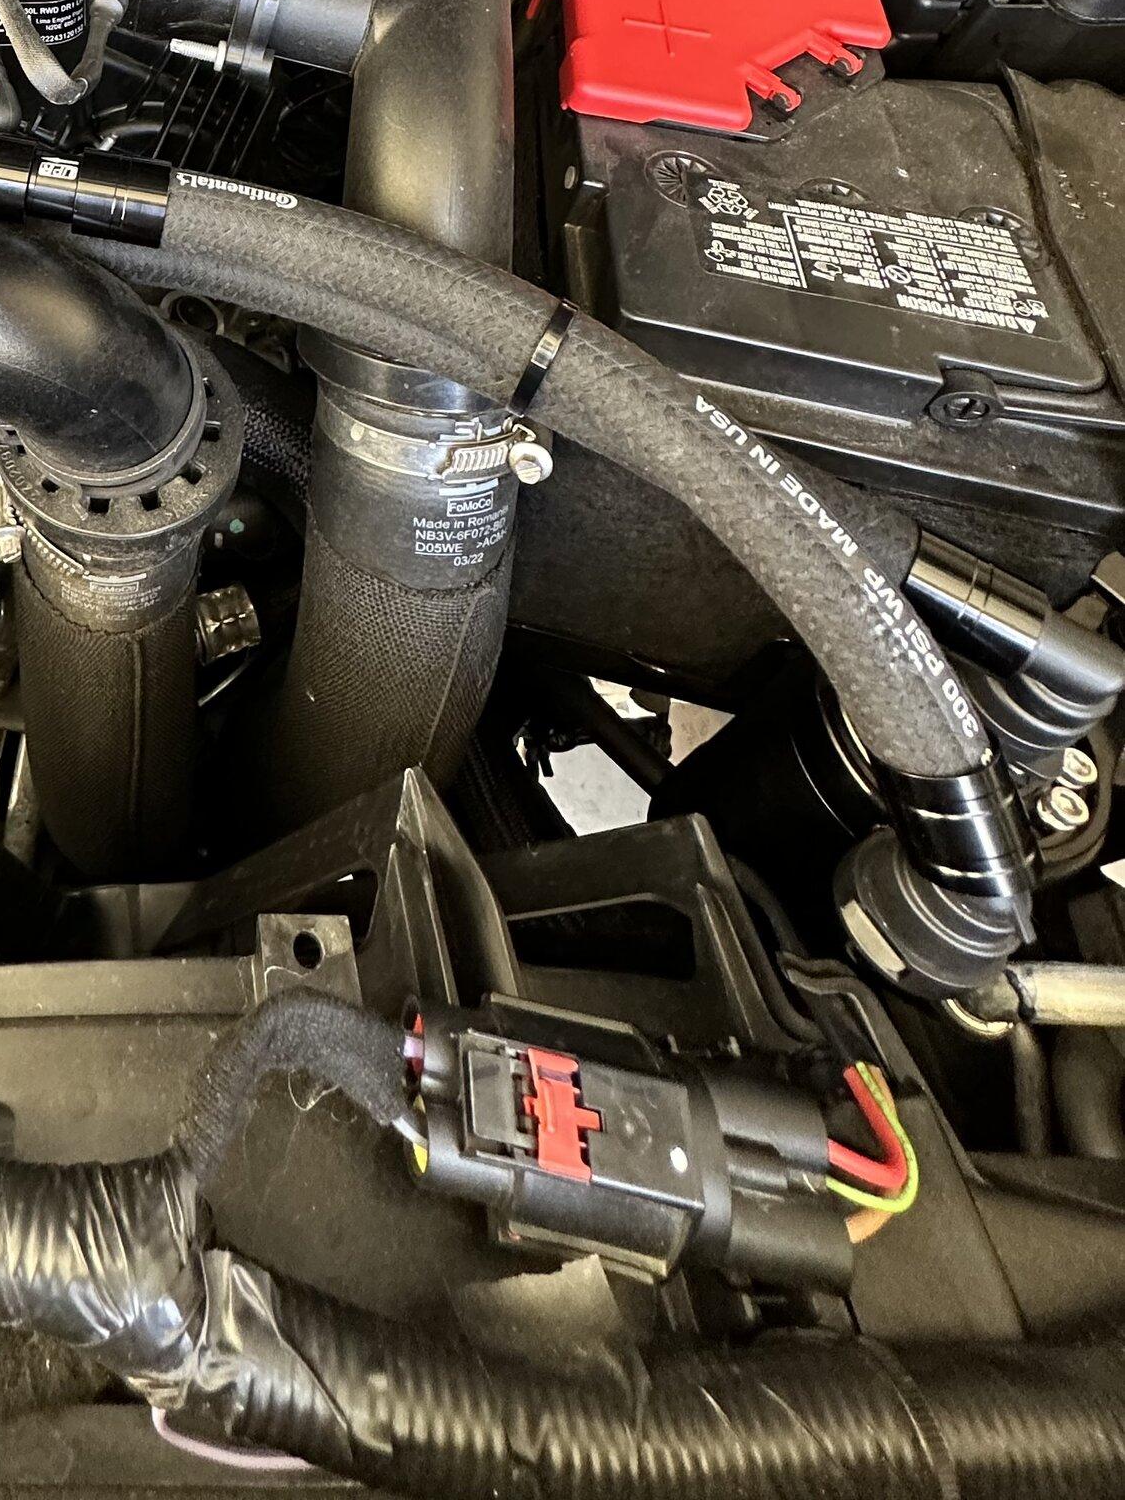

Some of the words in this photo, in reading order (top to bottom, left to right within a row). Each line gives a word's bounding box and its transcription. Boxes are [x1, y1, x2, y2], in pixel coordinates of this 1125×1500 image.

[40, 5, 59, 15] RWD
[176, 172, 298, 209] Continental
[895, 293, 1018, 330] DANGER/POISON
[696, 395, 748, 446] USA
[749, 445, 781, 475] IN
[413, 517, 450, 529] Made
[454, 520, 465, 529] in
[449, 498, 491, 512] FoMoCo
[779, 473, 859, 557] MADE
[415, 541, 463, 553] D05WE
[453, 552, 484, 567] 03/22
[863, 567, 905, 621] WP
[904, 619, 944, 677] PSI
[942, 678, 978, 738] 300
